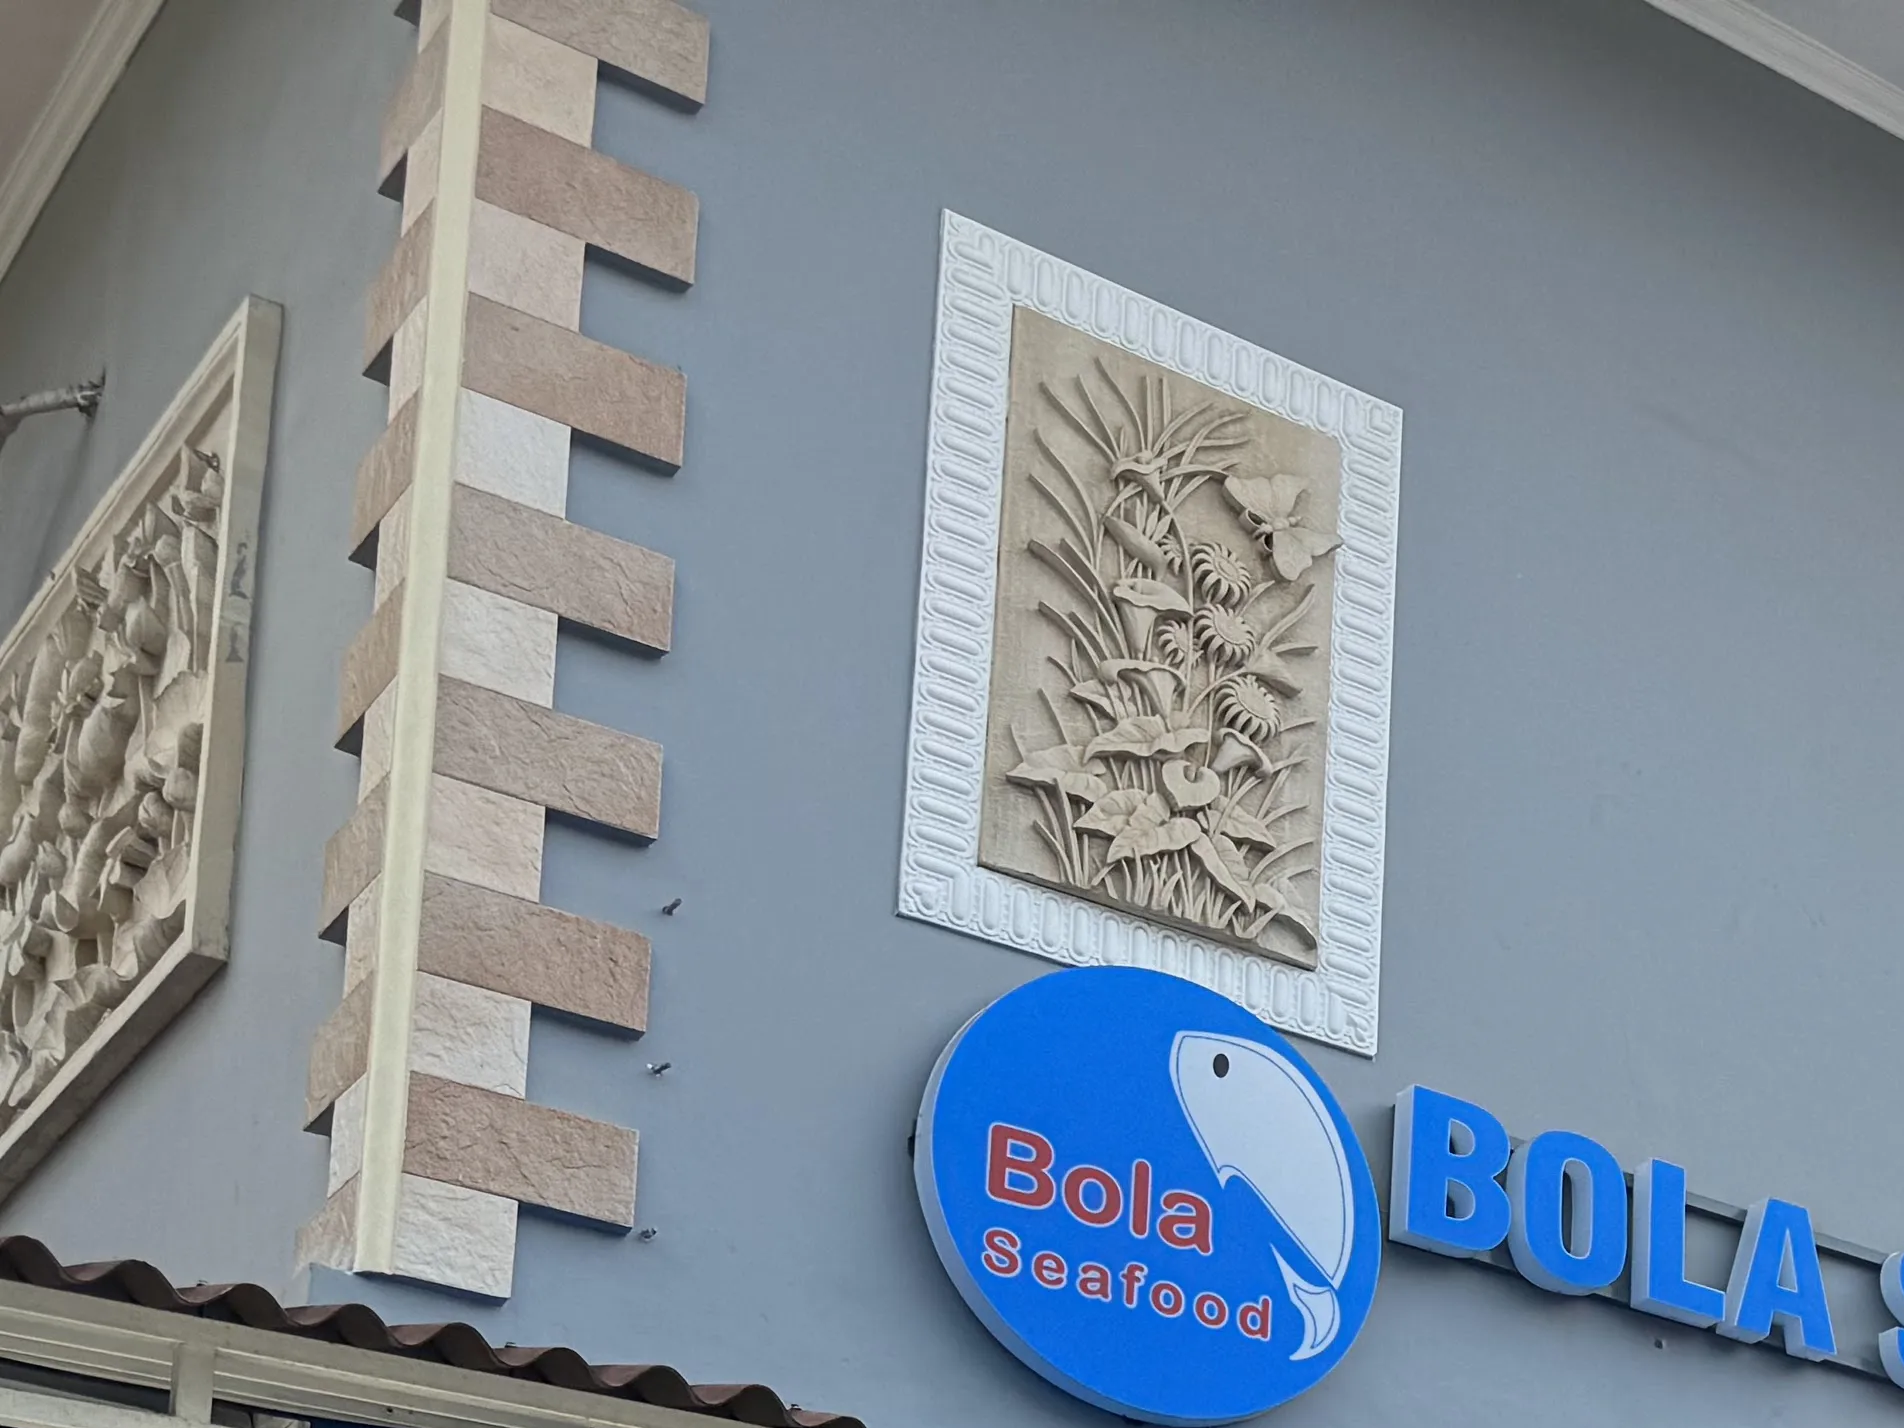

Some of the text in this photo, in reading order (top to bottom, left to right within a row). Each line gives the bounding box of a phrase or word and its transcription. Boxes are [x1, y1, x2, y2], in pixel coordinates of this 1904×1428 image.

[984, 1120, 1216, 1256] Bola
[1390, 1083, 1836, 1362] BOLA
[980, 1226, 1275, 1346] Seafood
